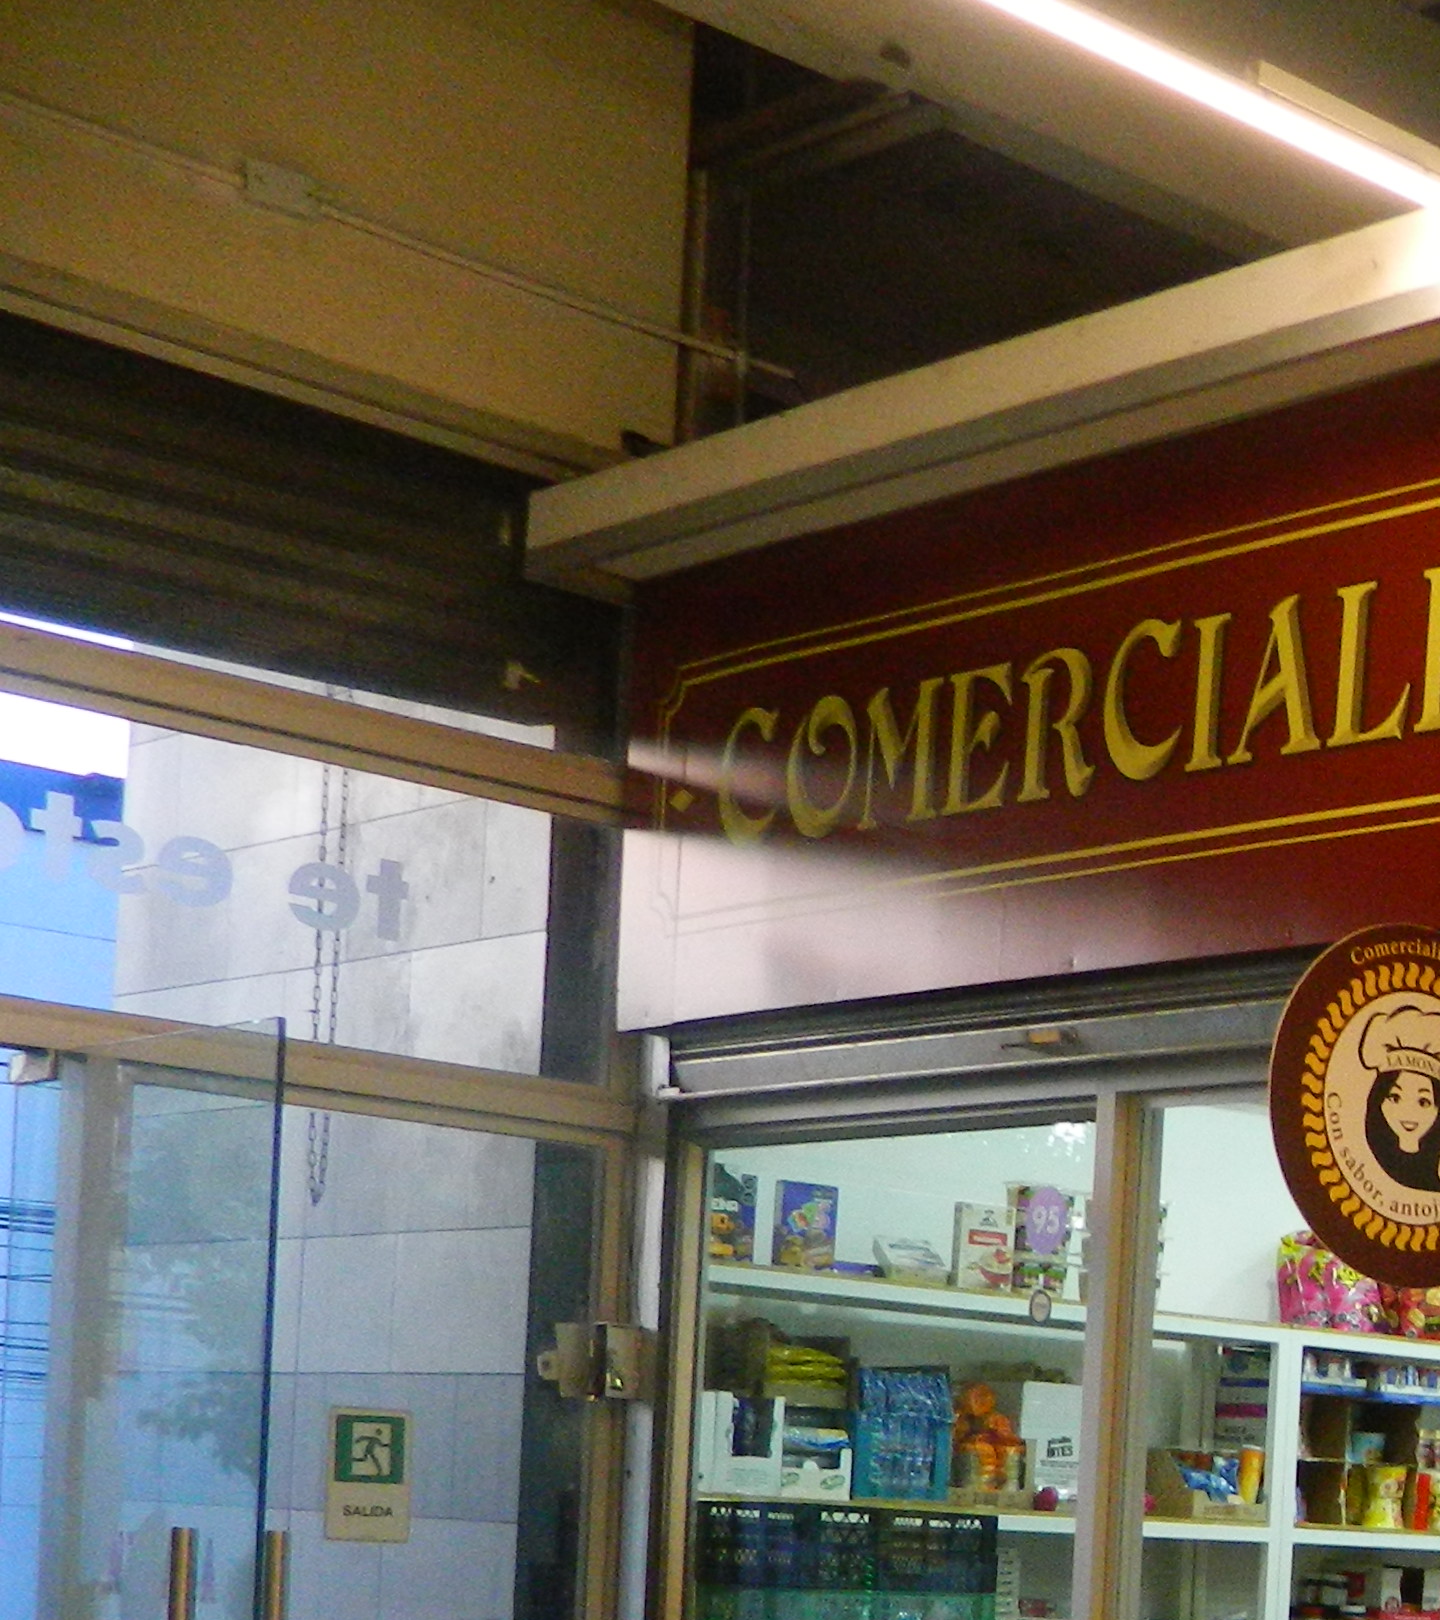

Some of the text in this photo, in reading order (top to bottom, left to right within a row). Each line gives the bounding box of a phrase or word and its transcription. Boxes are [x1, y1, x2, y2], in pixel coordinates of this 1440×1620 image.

[1326, 1091, 1345, 1141] Con
[1339, 1147, 1386, 1207] sabor,
[1031, 1207, 1060, 1234] 95
[341, 1503, 394, 1519] SALIDA
